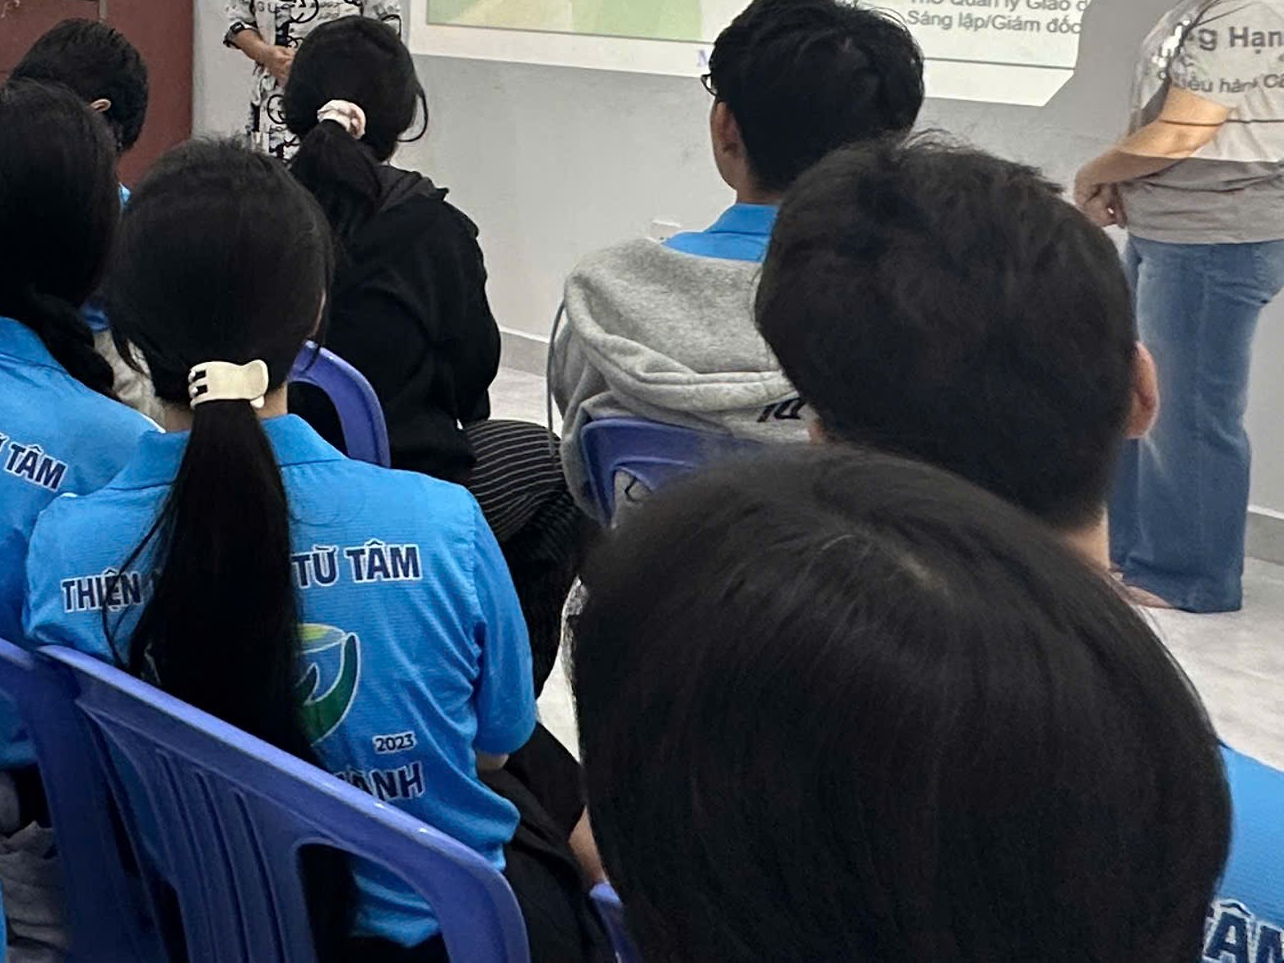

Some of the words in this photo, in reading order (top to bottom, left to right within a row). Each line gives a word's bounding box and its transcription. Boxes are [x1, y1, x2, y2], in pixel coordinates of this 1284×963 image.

[907, 10, 954, 31] Sáng
[958, 13, 1041, 33] lập/Giám
[4, 440, 69, 494] TÂM
[60, 567, 144, 614] THIỆN
[292, 543, 340, 590] TỪ
[343, 537, 423, 584] TÂM
[371, 731, 416, 755] 2023
